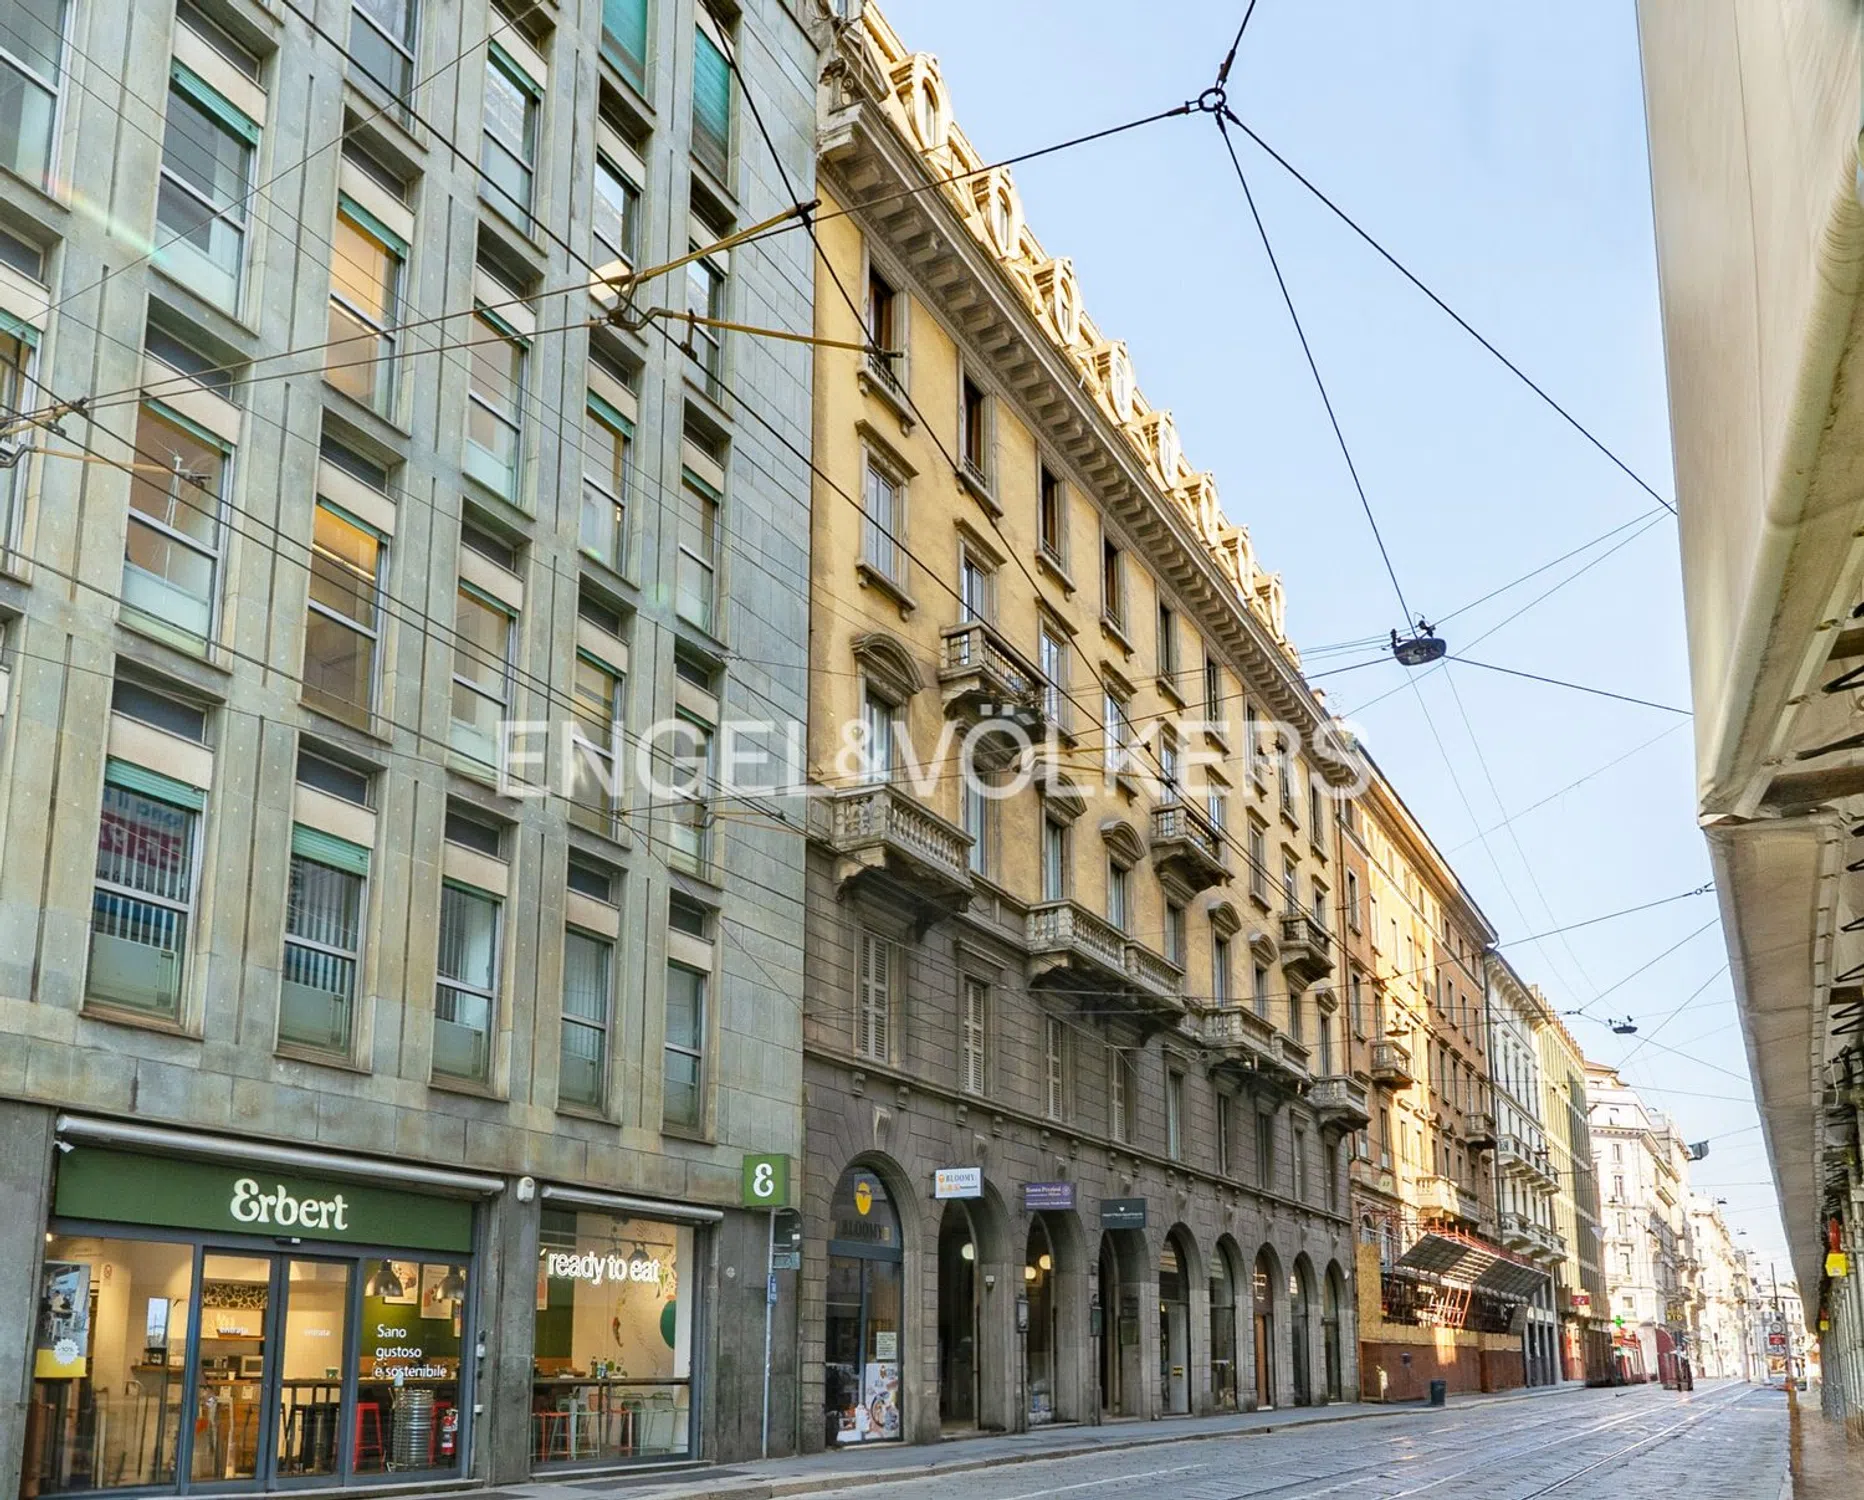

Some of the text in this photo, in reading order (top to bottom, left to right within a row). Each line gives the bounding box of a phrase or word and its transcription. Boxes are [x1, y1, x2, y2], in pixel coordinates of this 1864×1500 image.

[230, 1178, 349, 1231] Erbert
[547, 1252, 662, 1285] ready to eat
[377, 1324, 407, 1339] Sano
[375, 1346, 423, 1361] gustoso
[386, 1364, 447, 1378] sostenibile
